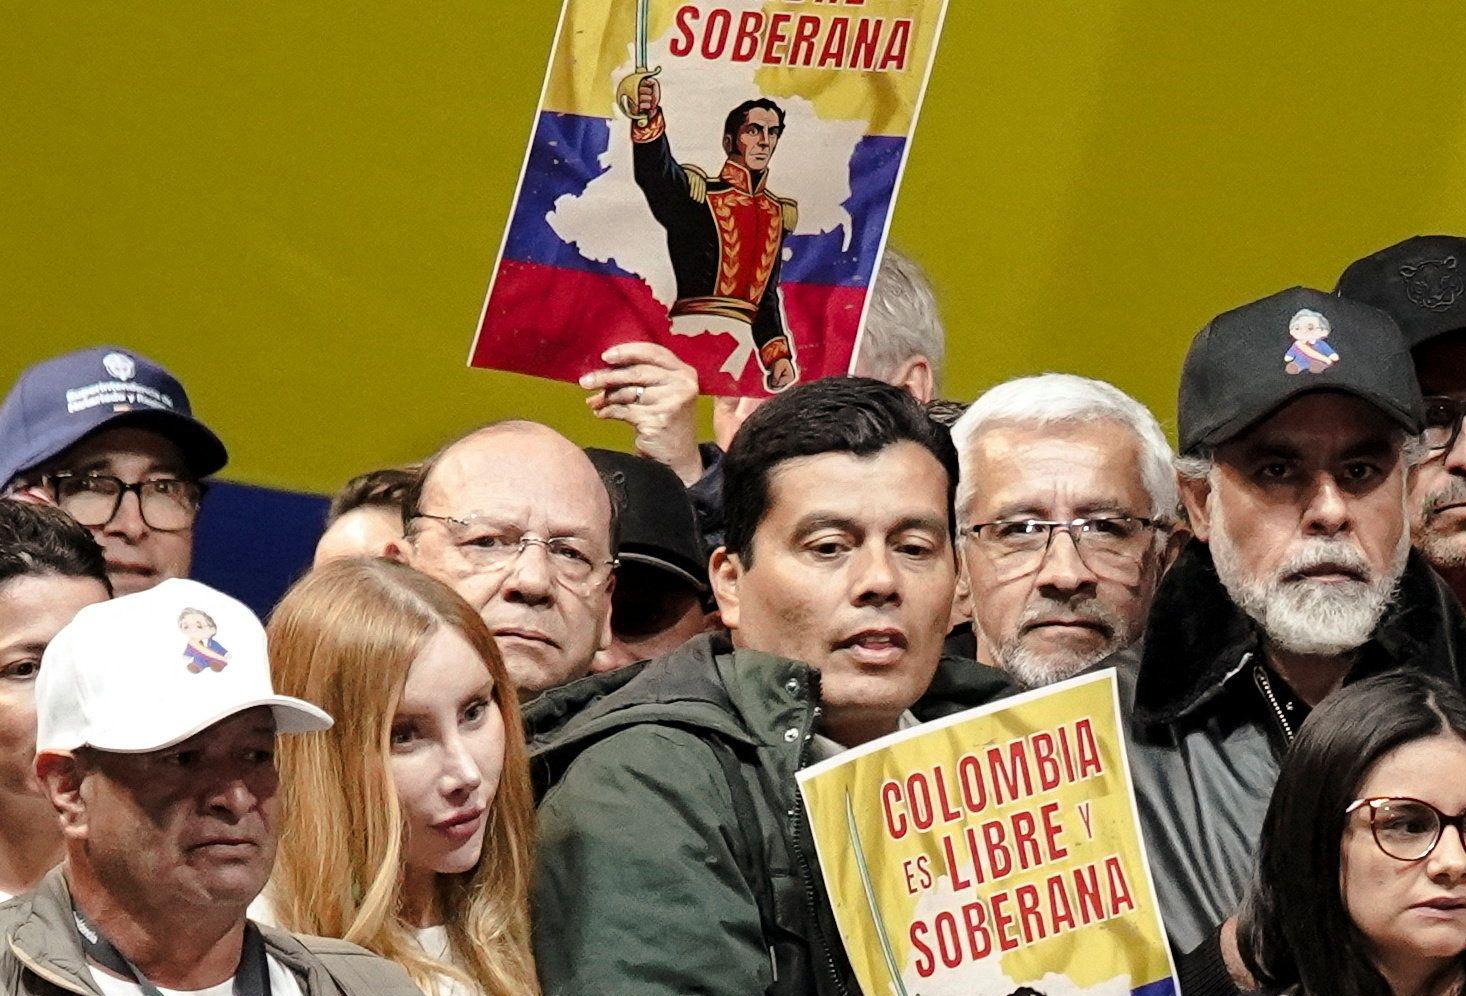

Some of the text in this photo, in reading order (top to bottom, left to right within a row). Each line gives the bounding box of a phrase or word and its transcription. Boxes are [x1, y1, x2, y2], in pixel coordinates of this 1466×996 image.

[669, 5, 912, 70] SOBERANA
[882, 718, 1101, 840] COLOMBIA
[904, 802, 1092, 895] ES LIBRE Y
[909, 857, 1134, 978] SOBERANA
